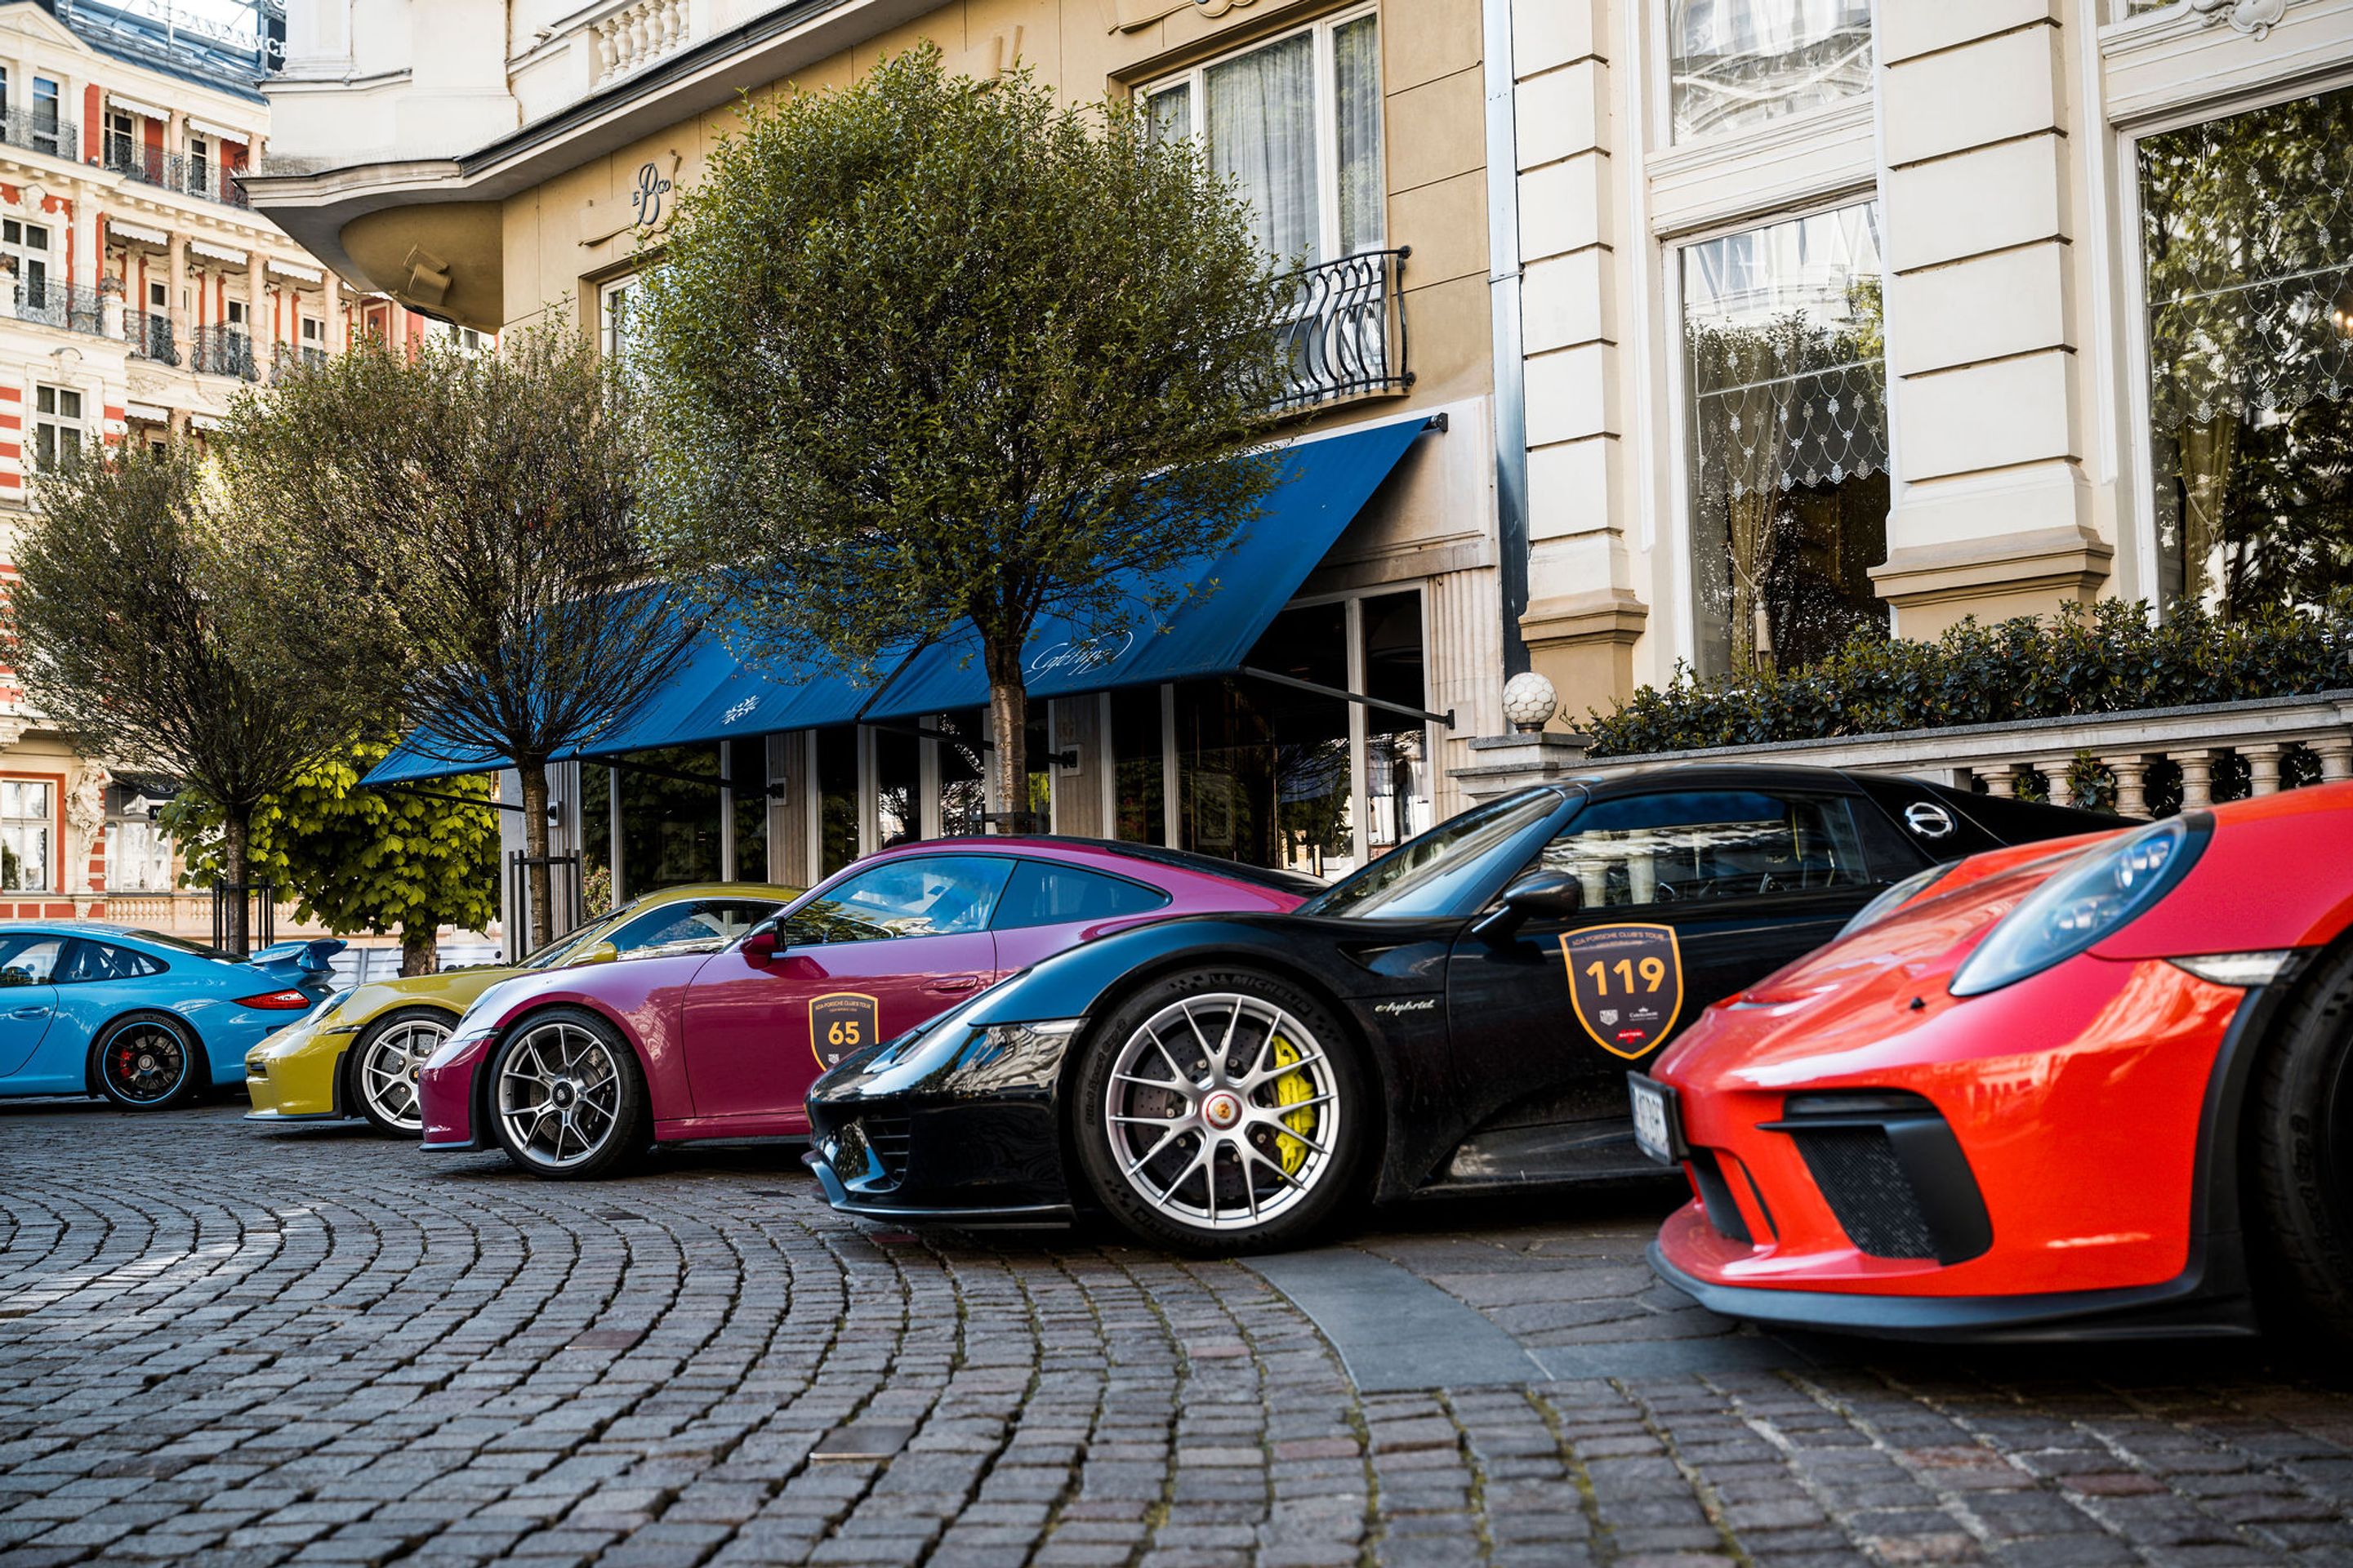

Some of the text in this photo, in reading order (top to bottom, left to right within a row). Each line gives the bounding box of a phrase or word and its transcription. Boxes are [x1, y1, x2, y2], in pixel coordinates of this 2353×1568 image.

[1232, 974, 1312, 1014] MICHELIN
[1585, 956, 1665, 996] 119
[828, 1021, 861, 1045] 65
